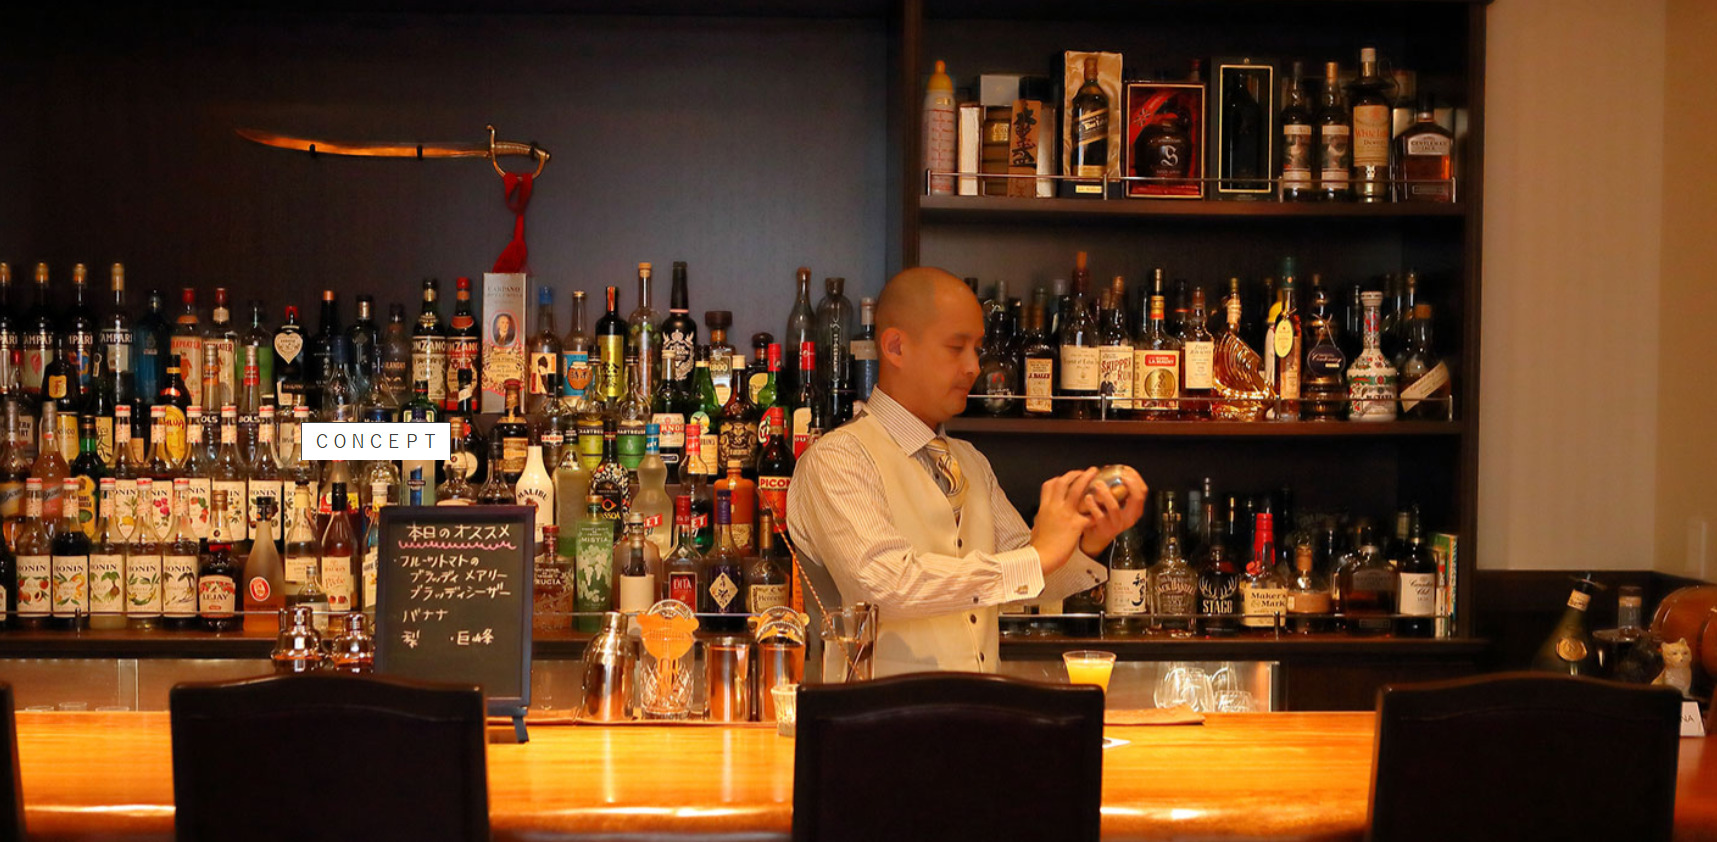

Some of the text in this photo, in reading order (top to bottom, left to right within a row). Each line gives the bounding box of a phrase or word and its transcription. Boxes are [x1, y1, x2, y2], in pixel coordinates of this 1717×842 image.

[200, 415, 218, 423] OLS
[406, 522, 511, 542] 本日のオススメ
[535, 578, 562, 586] RUCIA
[673, 578, 692, 590] DITA
[410, 582, 511, 602] ブラッディシーザー
[402, 608, 449, 623] バナナ
